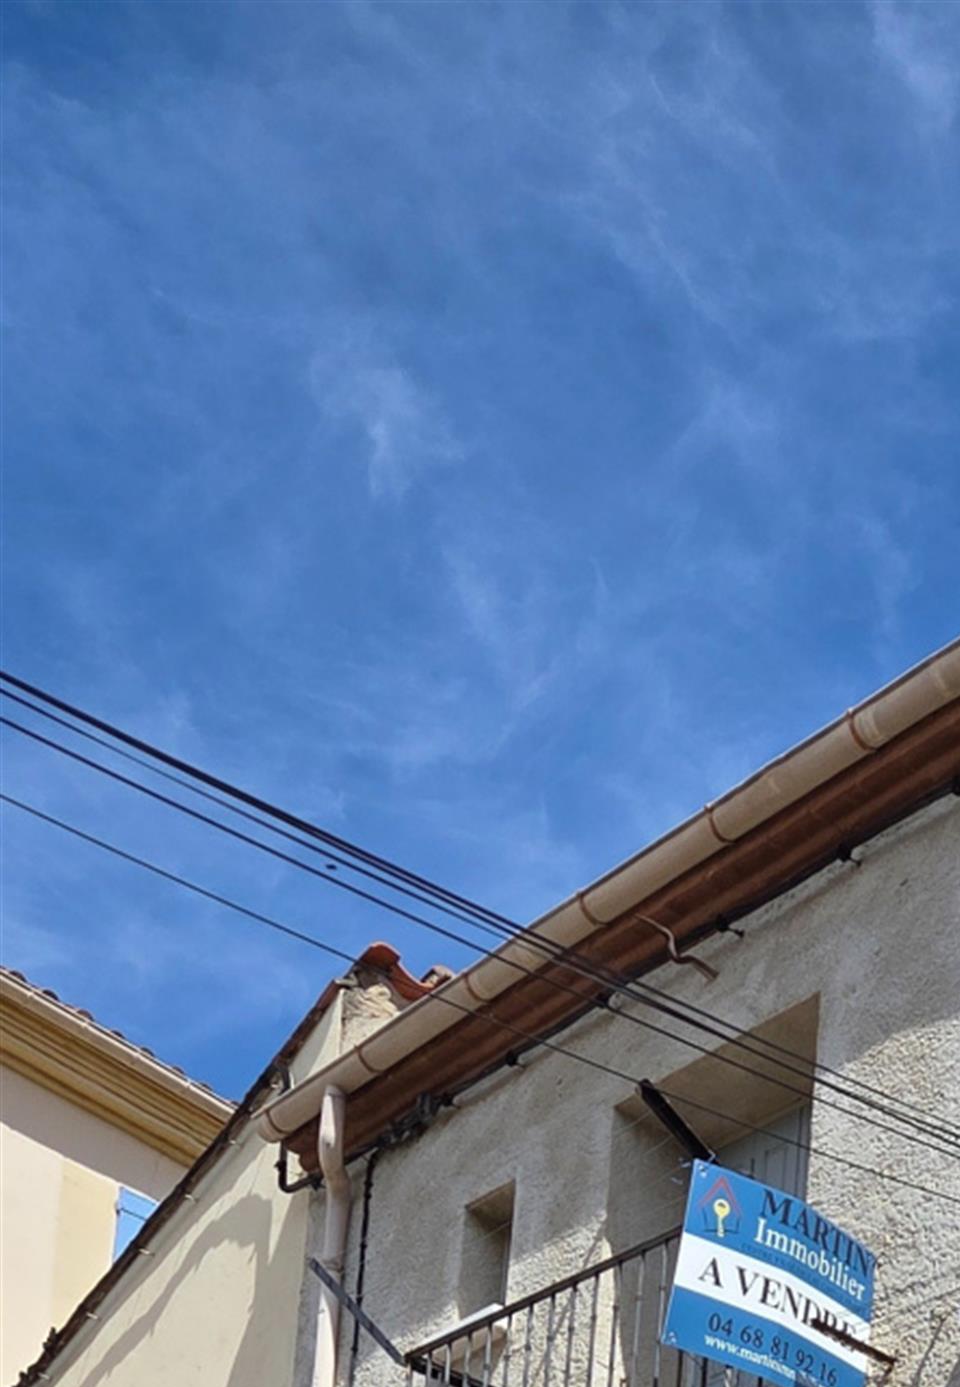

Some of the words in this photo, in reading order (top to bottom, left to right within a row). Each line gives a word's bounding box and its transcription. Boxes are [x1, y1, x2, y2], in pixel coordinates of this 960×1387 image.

[698, 1257, 724, 1288] A
[753, 1217, 865, 1300] Immobilier
[759, 1189, 873, 1278] MARTIN
[708, 1312, 733, 1337] 04
[740, 1324, 764, 1348] 68
[770, 1335, 790, 1361] 81
[795, 1349, 814, 1374] 92
[819, 1362, 837, 1387] 16
